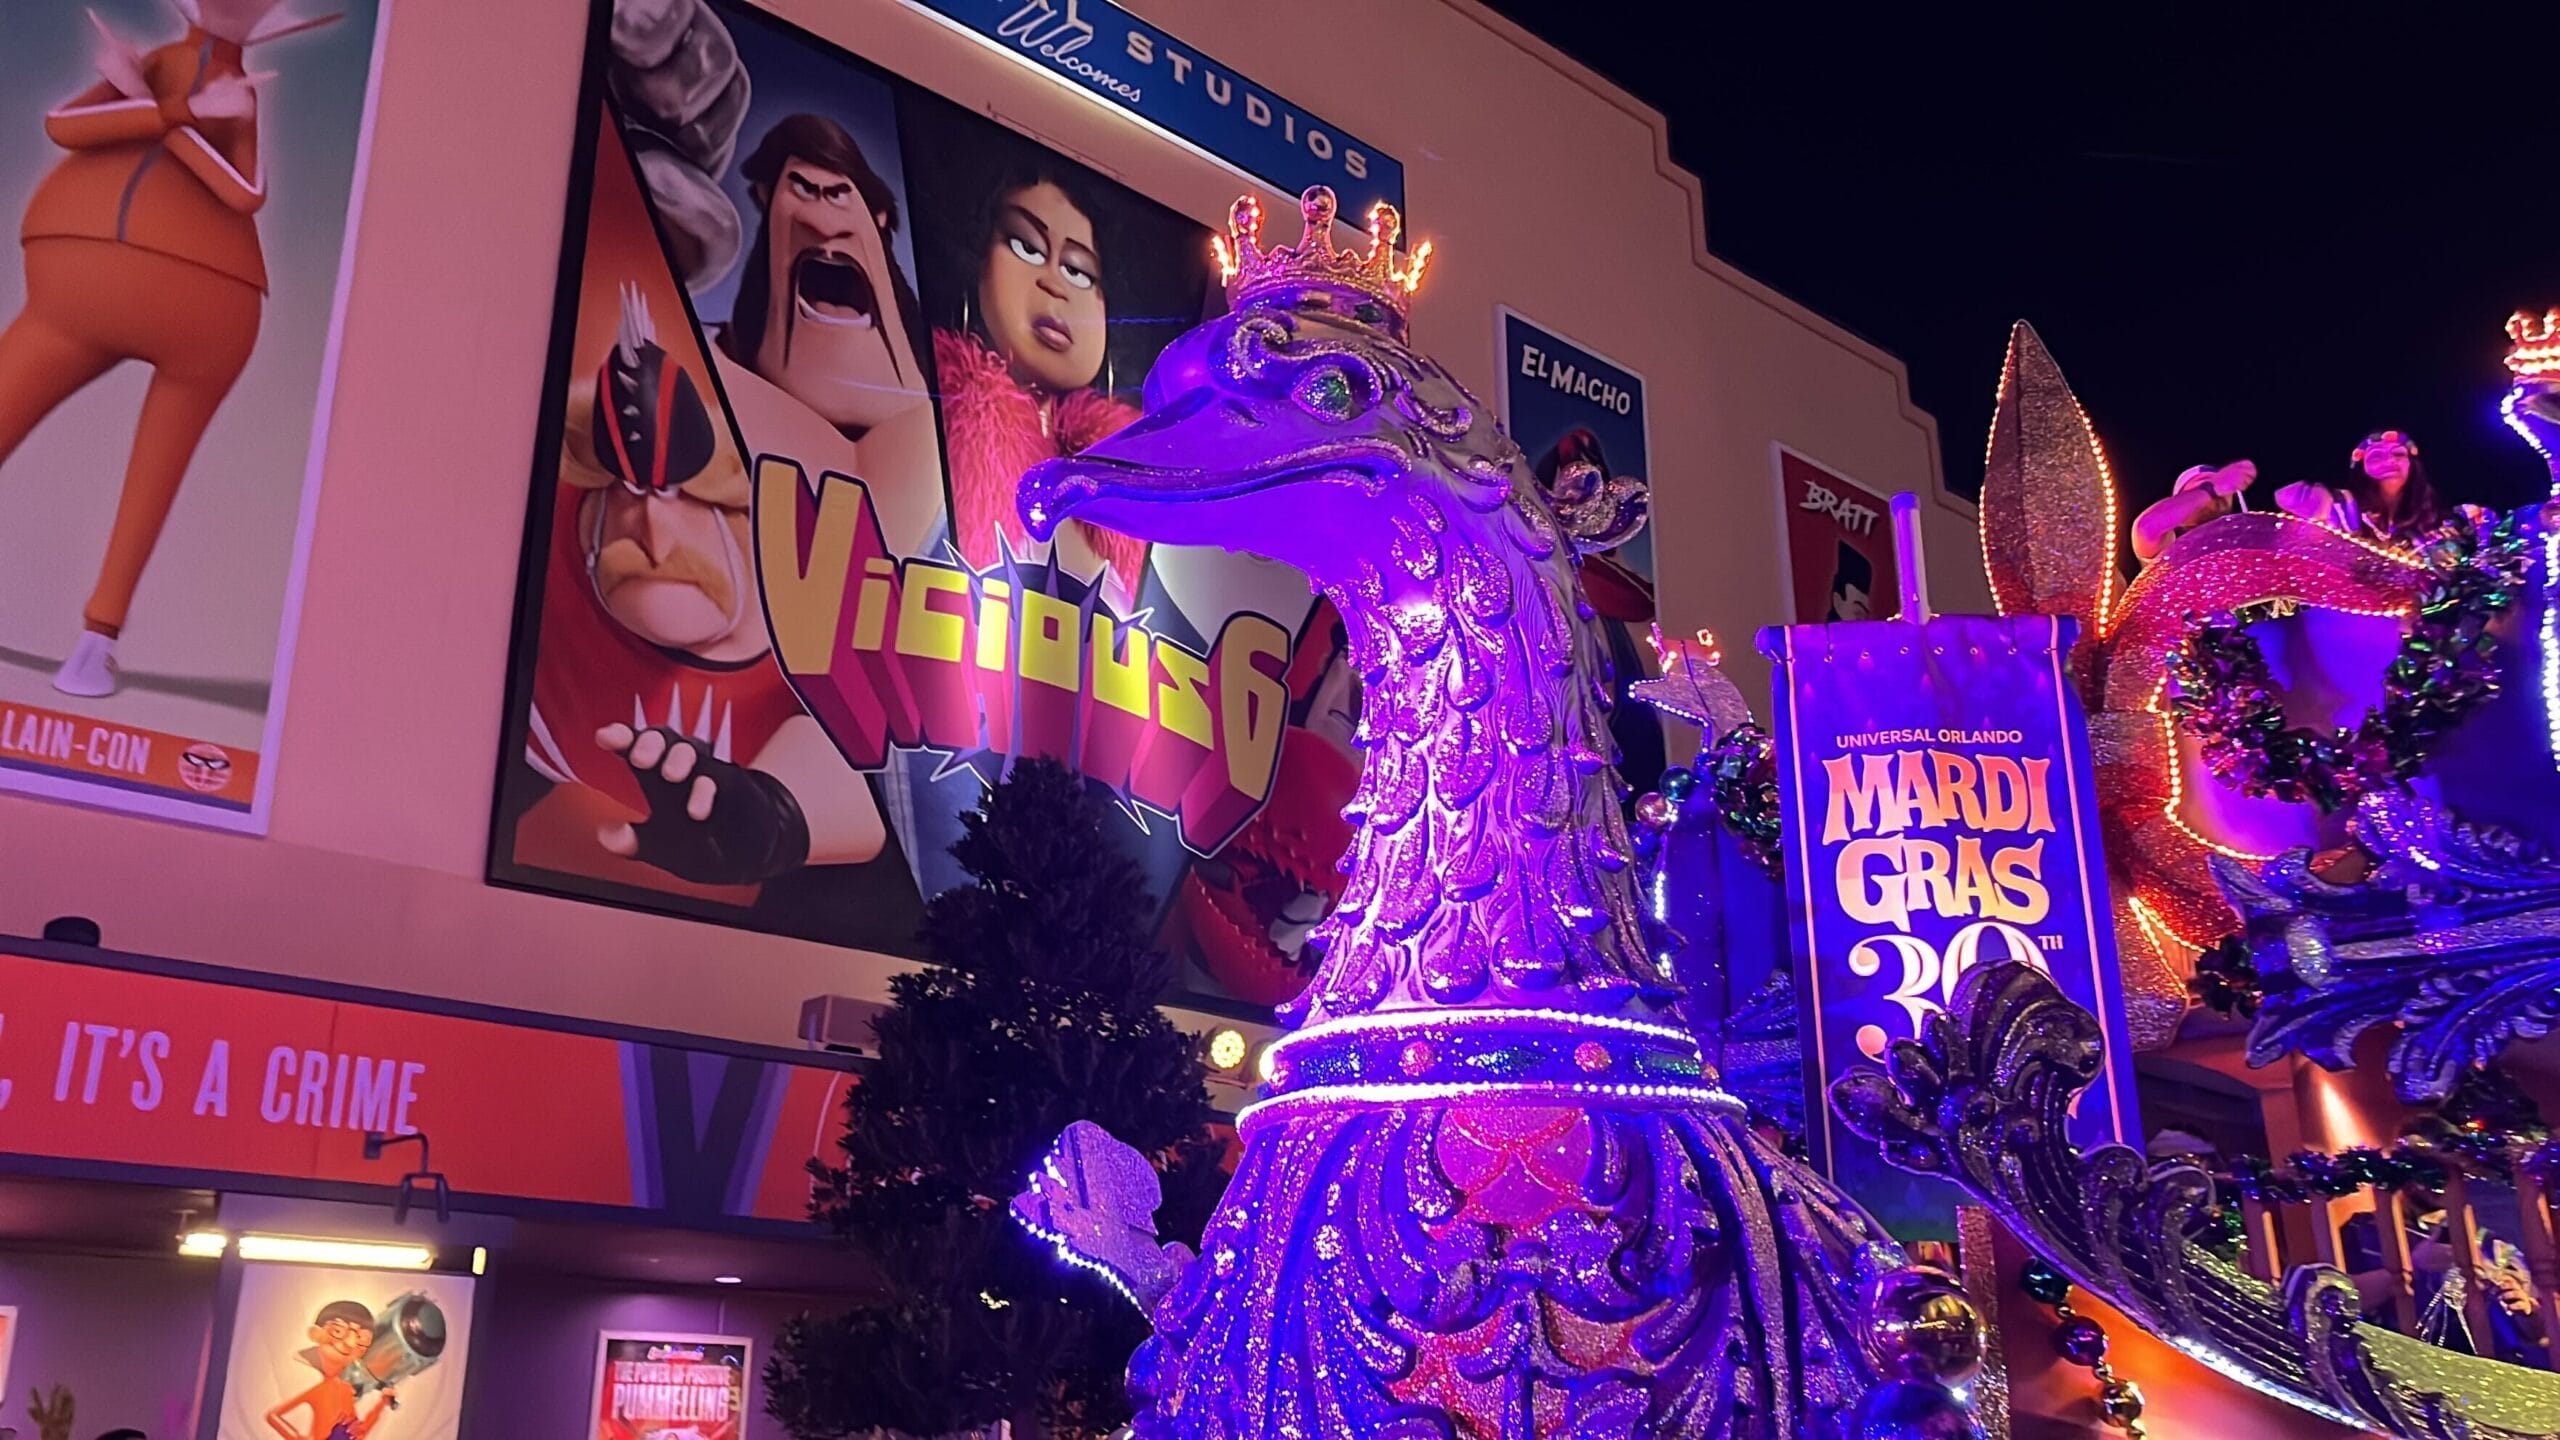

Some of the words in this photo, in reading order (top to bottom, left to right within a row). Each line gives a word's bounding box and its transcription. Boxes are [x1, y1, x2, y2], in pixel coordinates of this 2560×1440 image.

[997, 0, 1141, 102] Welcomes
[1126, 30, 1368, 180] STUDIOS
[1521, 344, 1548, 378] EL
[1550, 360, 1631, 415] MACHO
[1799, 480, 1880, 536] BRATT
[0, 709, 151, 775] LAIN-CON
[1836, 729, 1935, 748] UNIVERSAL
[1938, 729, 2022, 744] ORLANDO
[1822, 748, 2056, 846] MARDI
[1836, 833, 2050, 932] GRAS
[54, 1021, 170, 1111] IT'S
[193, 1039, 230, 1118] A
[260, 1046, 426, 1135] CRIME
[611, 1383, 730, 1422] PUMMELLING
